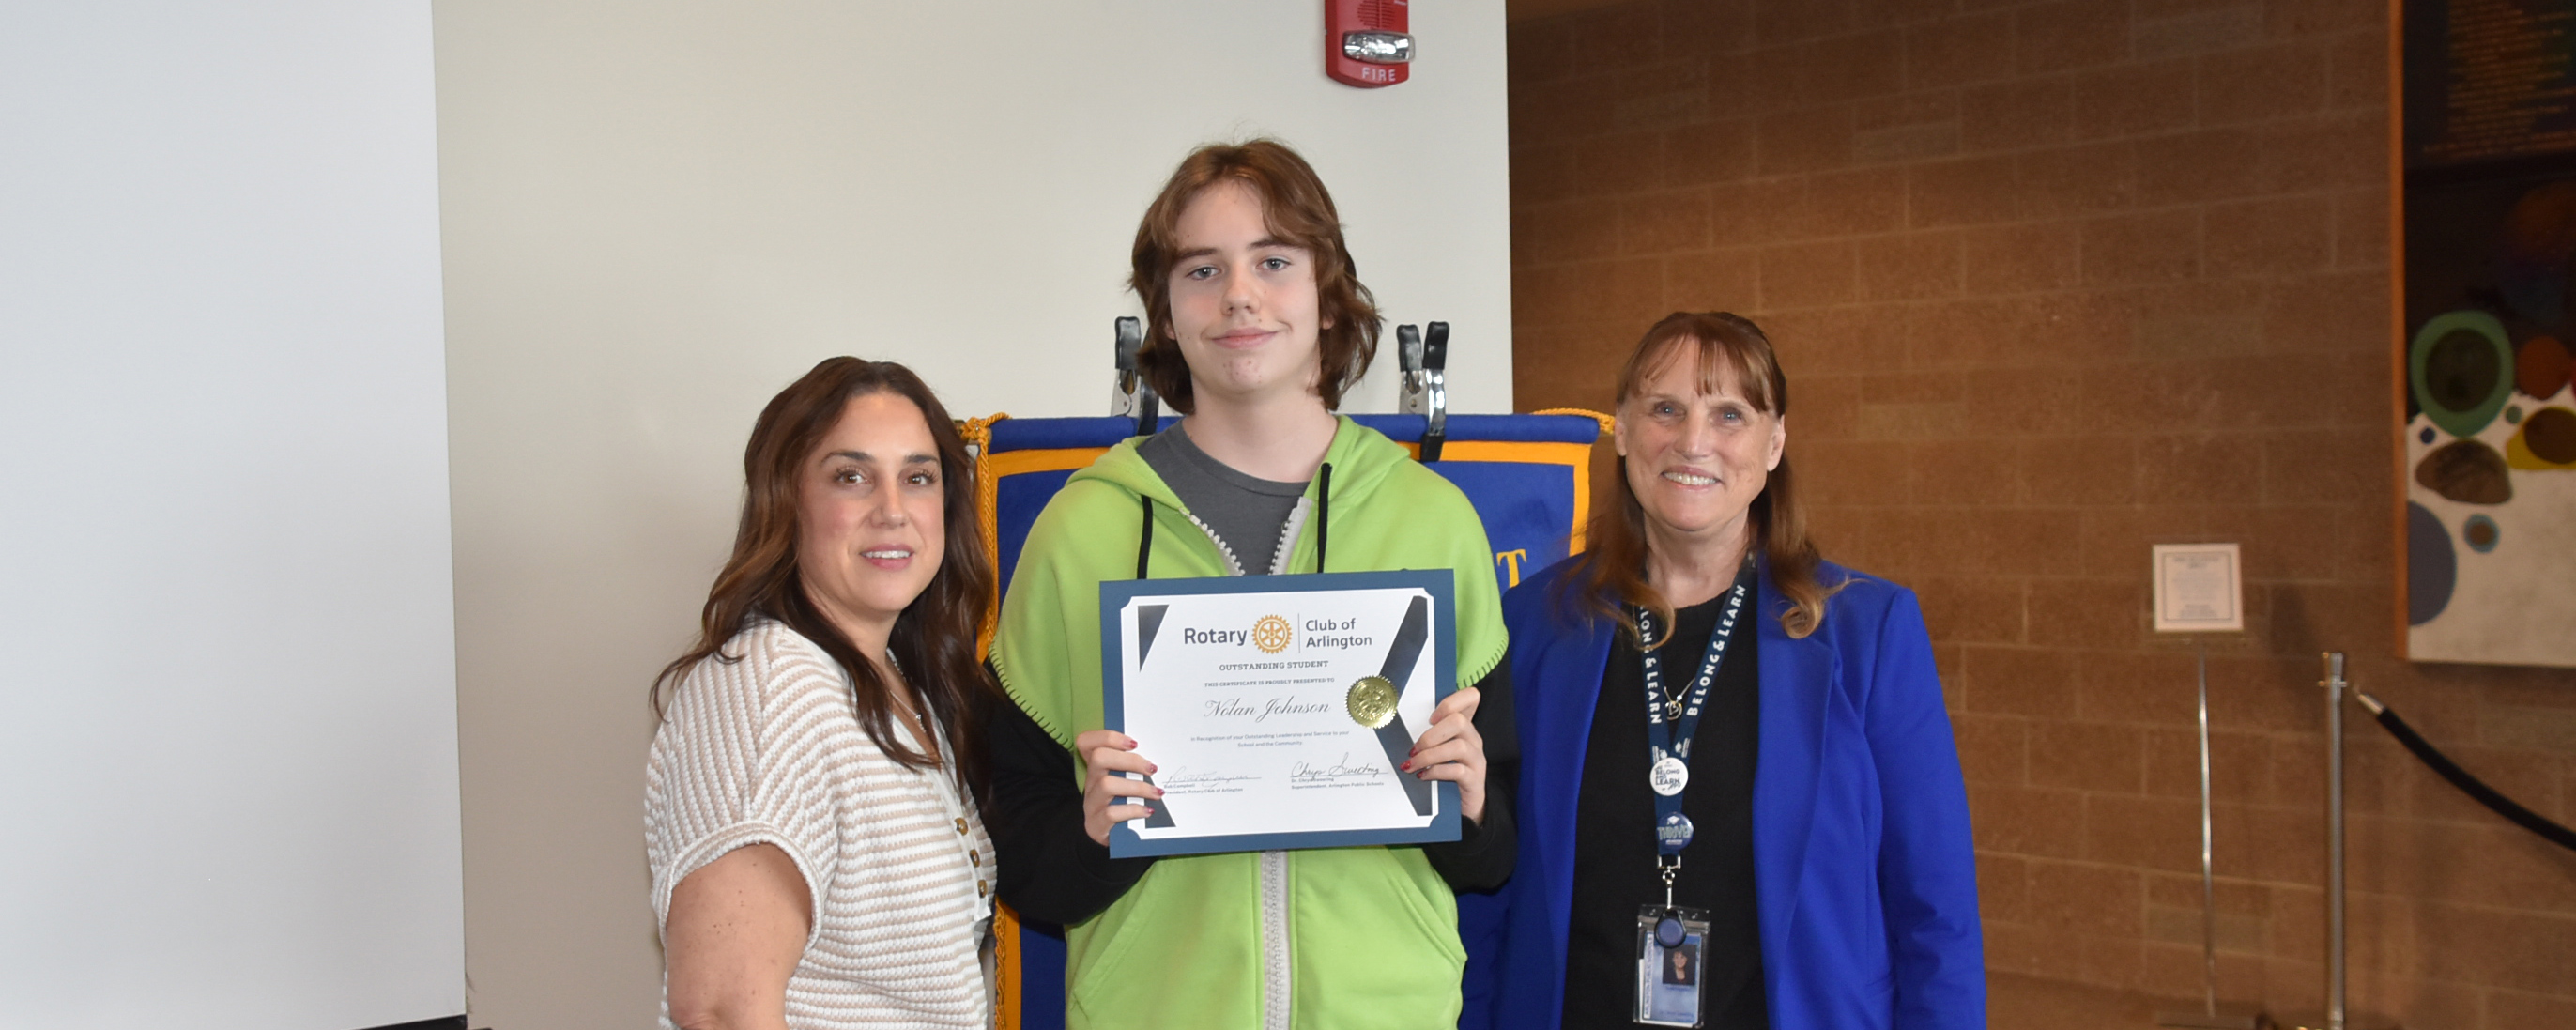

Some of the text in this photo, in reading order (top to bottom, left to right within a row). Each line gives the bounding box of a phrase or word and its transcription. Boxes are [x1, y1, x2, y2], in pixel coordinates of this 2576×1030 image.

[1362, 67, 1396, 82] FIRE
[1305, 618, 1356, 632] Club of
[1184, 627, 1248, 646] Rotary
[1306, 635, 1372, 650] Arlington
[1686, 584, 1746, 716] BELONG & LEARN
[1219, 660, 1328, 671] OUTSTANDING STUDENT
[1645, 657, 1657, 669] &
[1646, 670, 1662, 724] LEARN
[1204, 698, 1256, 717] Nolan
[1255, 695, 1331, 723] Johnson
